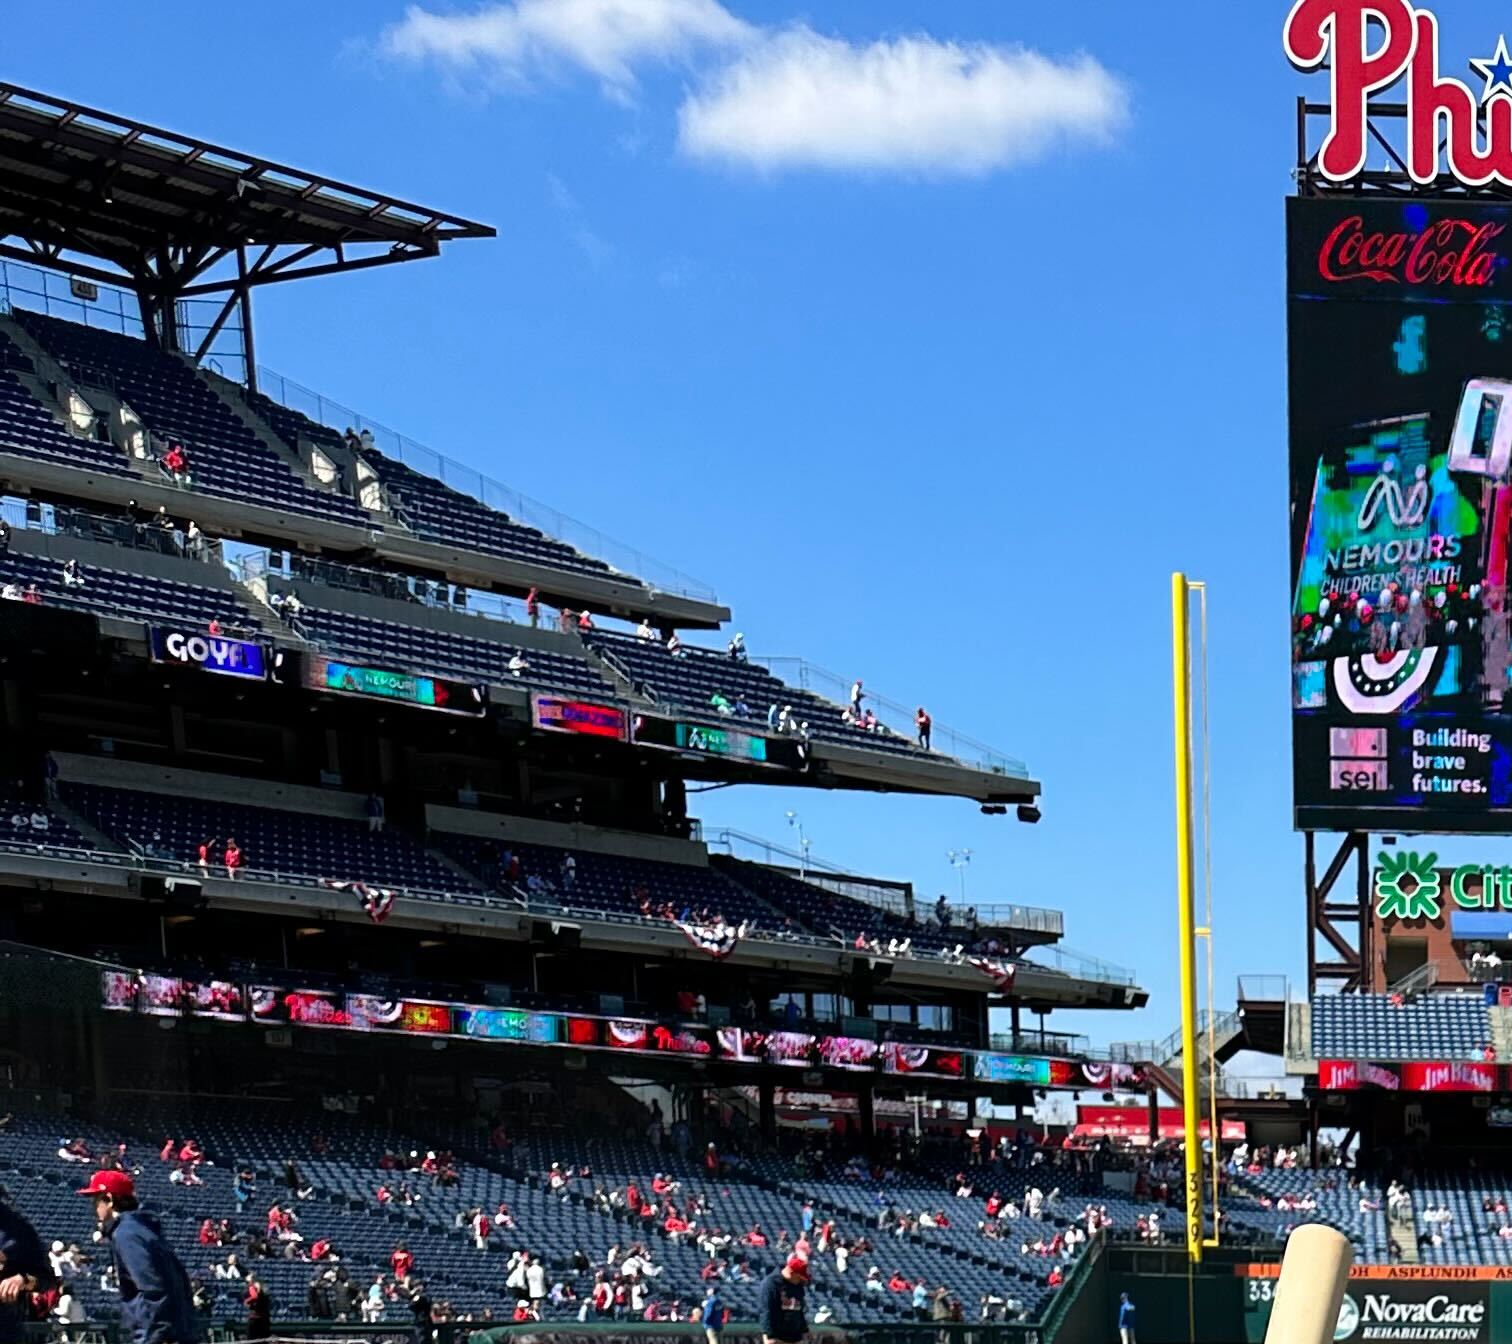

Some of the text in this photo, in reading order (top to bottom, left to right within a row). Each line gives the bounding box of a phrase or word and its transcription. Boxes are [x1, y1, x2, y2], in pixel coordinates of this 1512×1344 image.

[1322, 534, 1462, 572] NEMOURS
[1405, 565, 1461, 590] HEALTH
[1413, 729, 1492, 753] Building
[1413, 751, 1465, 769] brave
[1413, 773, 1488, 794] futures.
[1420, 1065, 1449, 1091] JIM
[1451, 1063, 1494, 1091] BEAM
[1388, 1267, 1477, 1279] ASPLUNDH
[1362, 1295, 1484, 1323] NovaCare
[1362, 1326, 1480, 1340] REHABILITATION
